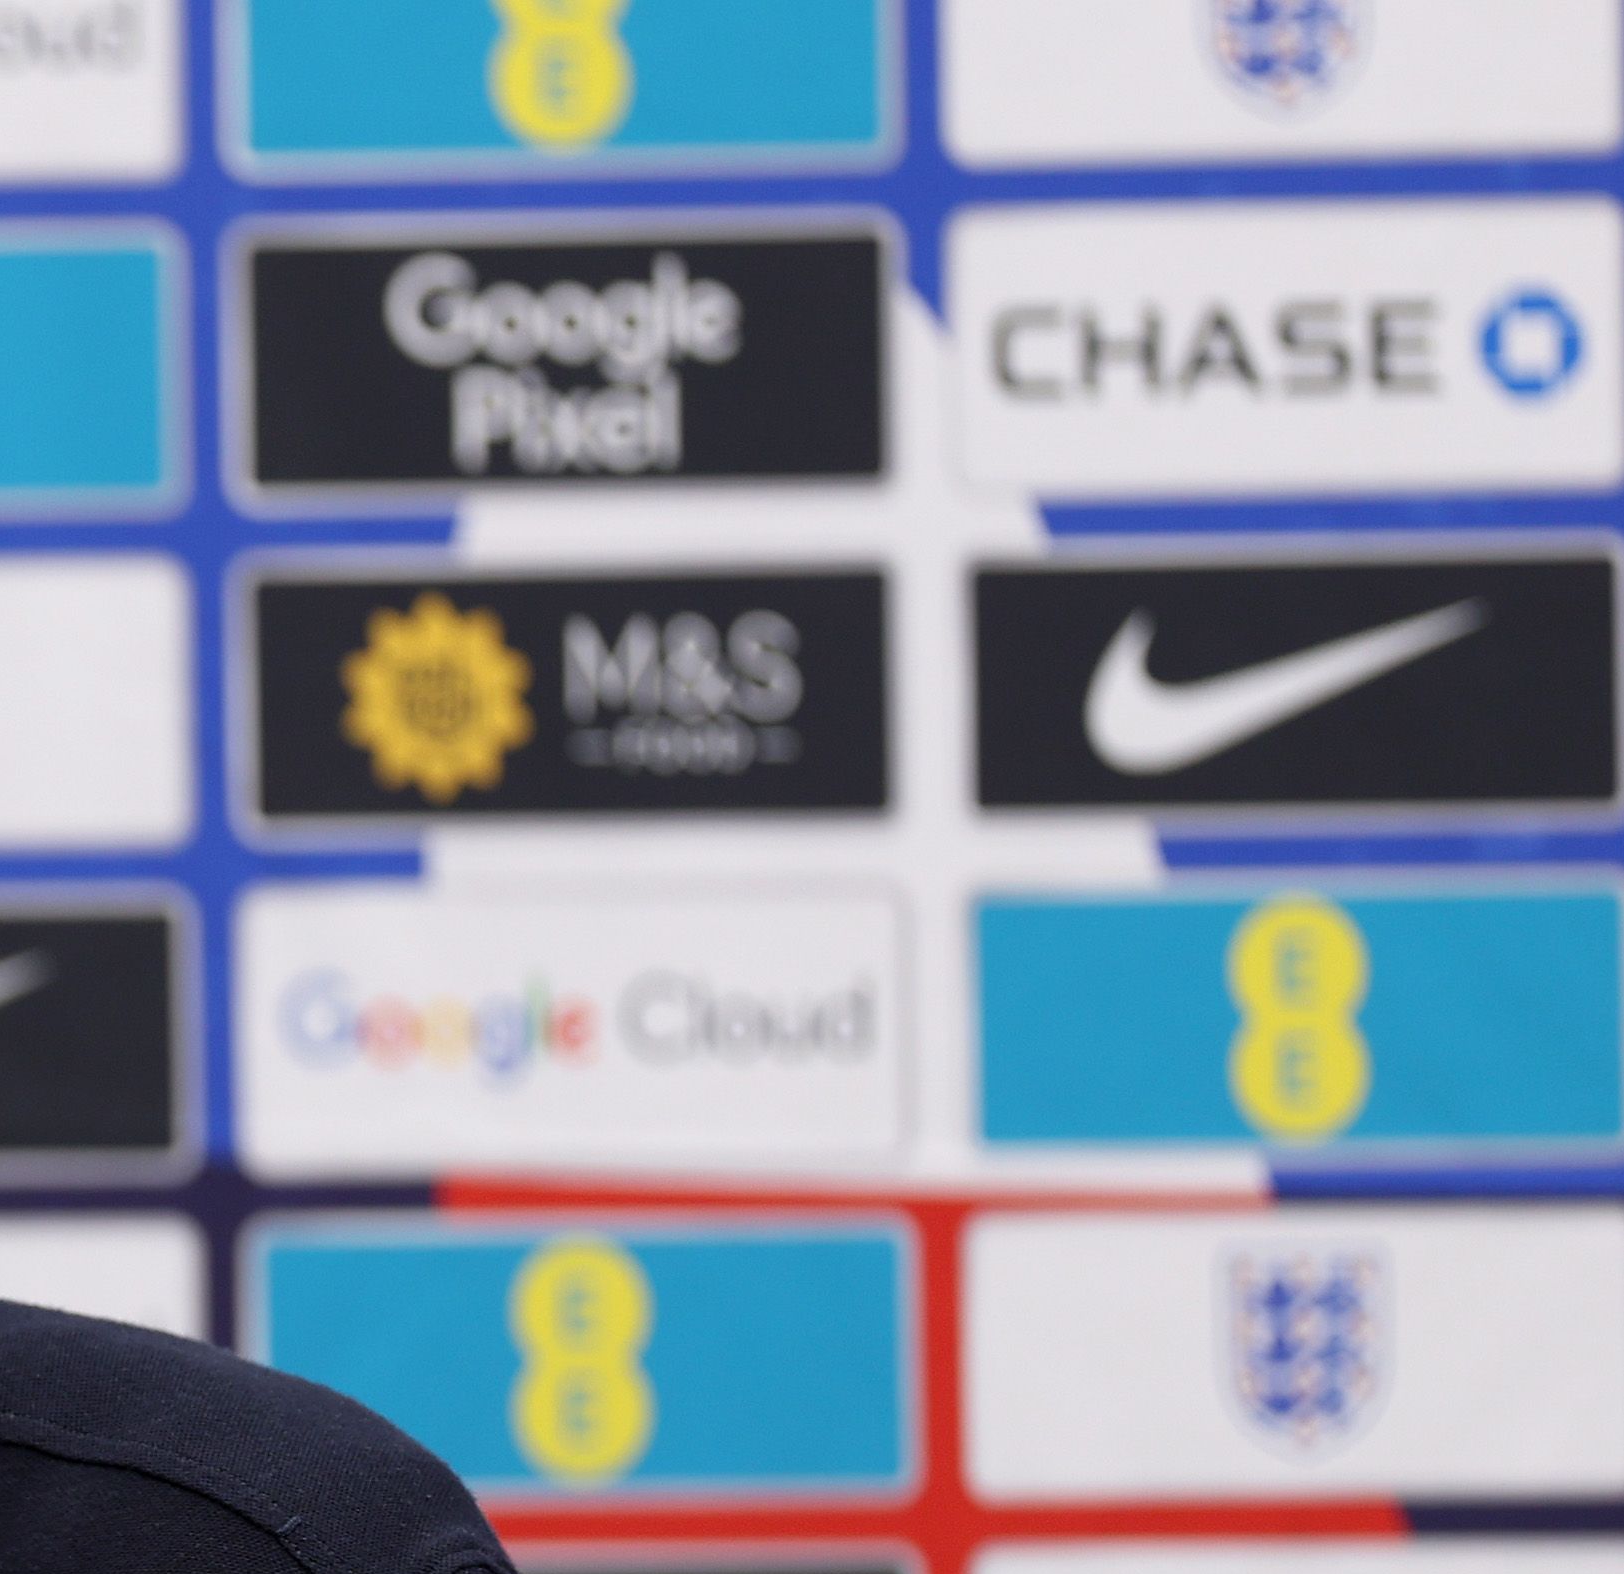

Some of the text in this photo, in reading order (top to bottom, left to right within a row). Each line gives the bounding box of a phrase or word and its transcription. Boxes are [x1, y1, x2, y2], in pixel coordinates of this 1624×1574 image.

[384, 250, 741, 390] Google
[988, 297, 1438, 402] CHASE
[451, 366, 682, 472] Pixel
[562, 610, 802, 724] M&S
[277, 966, 878, 1092] Google Cloud
